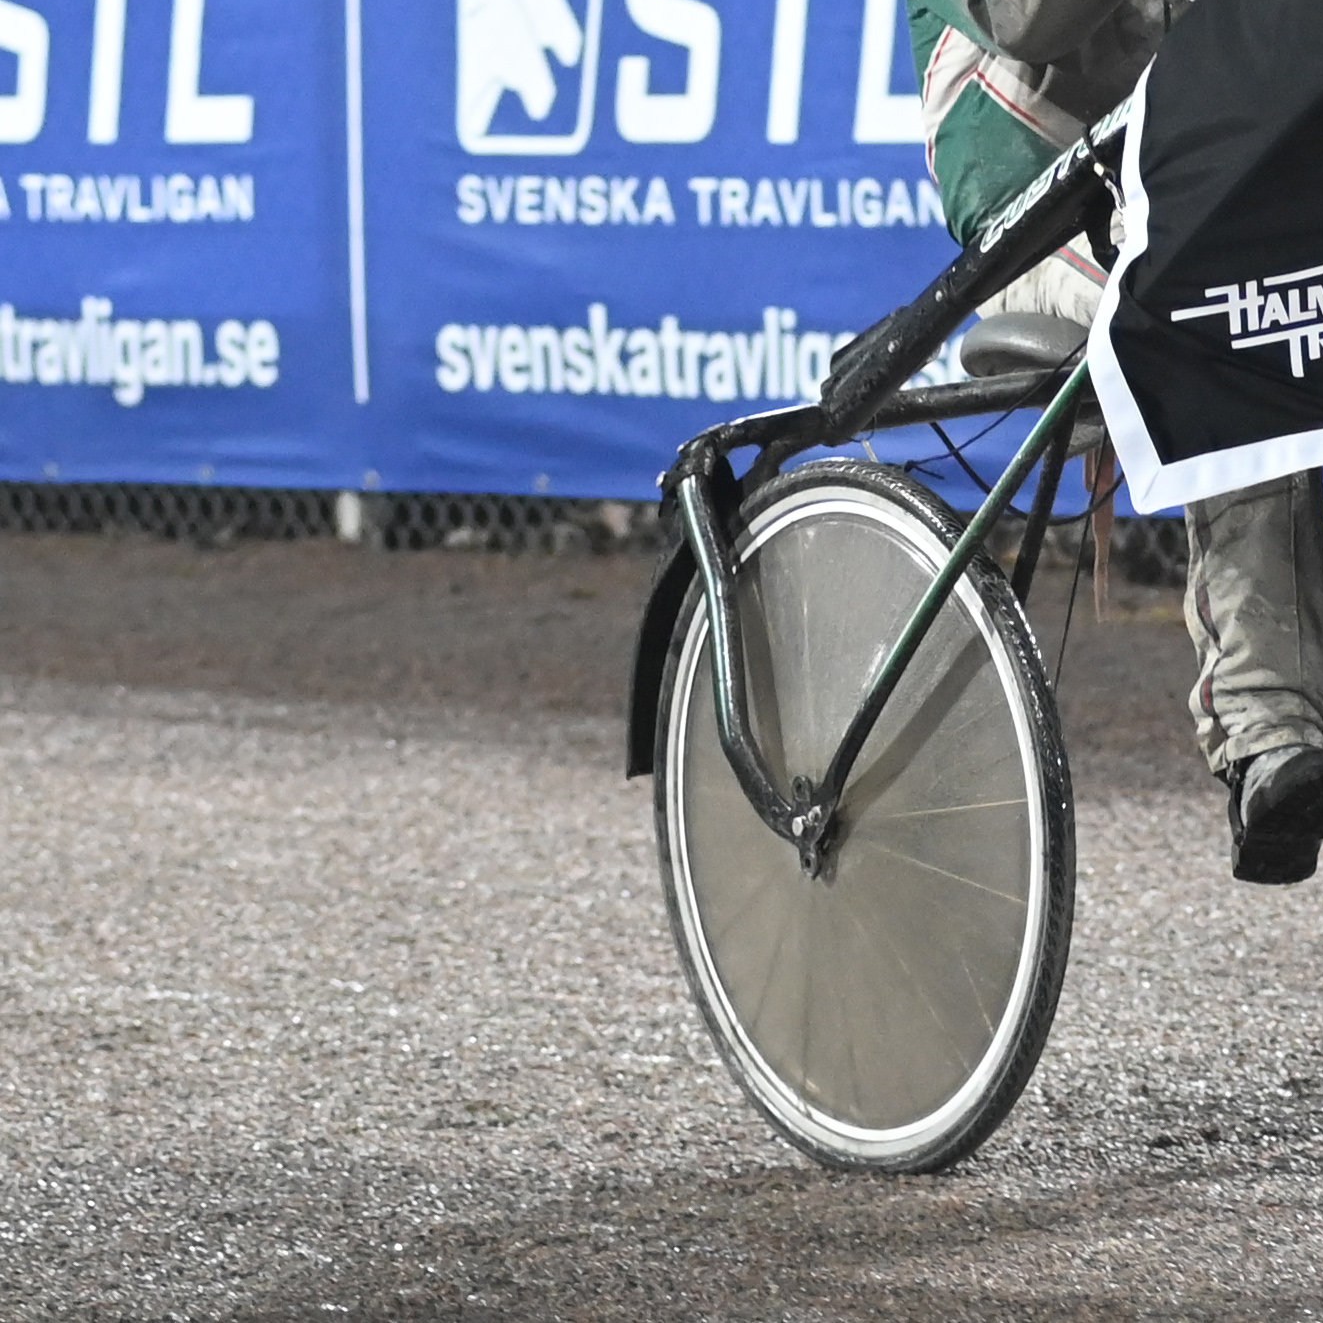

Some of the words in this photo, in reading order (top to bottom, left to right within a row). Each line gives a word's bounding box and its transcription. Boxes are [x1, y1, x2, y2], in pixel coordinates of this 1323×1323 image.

[18, 173, 255, 223] TRAVLIGAN
[456, 174, 675, 226] SVENSKA
[687, 175, 946, 228] TRAVLIGAN
